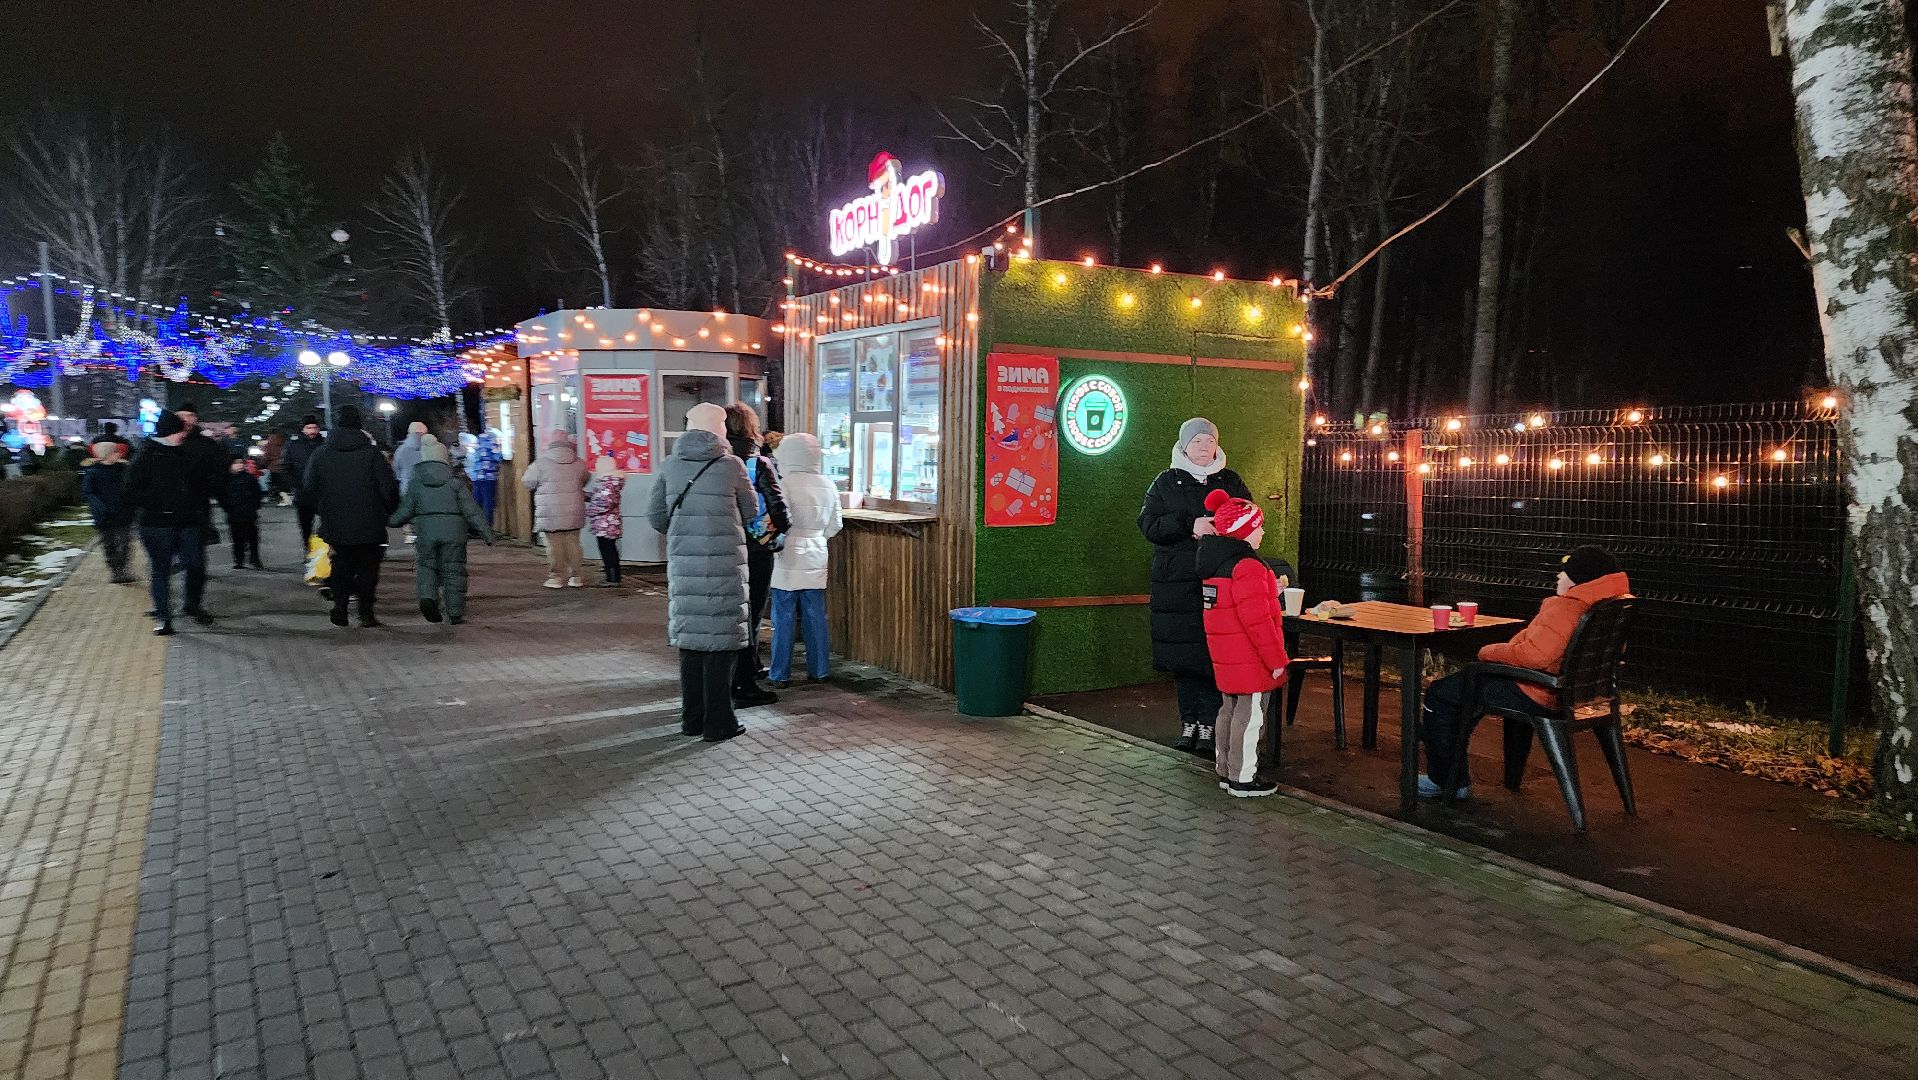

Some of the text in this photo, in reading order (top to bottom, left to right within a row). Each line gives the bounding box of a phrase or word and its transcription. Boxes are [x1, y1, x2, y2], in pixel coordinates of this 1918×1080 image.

[832, 175, 937, 254] КОРН ДОГ
[998, 366, 1048, 384] ЗИМА
